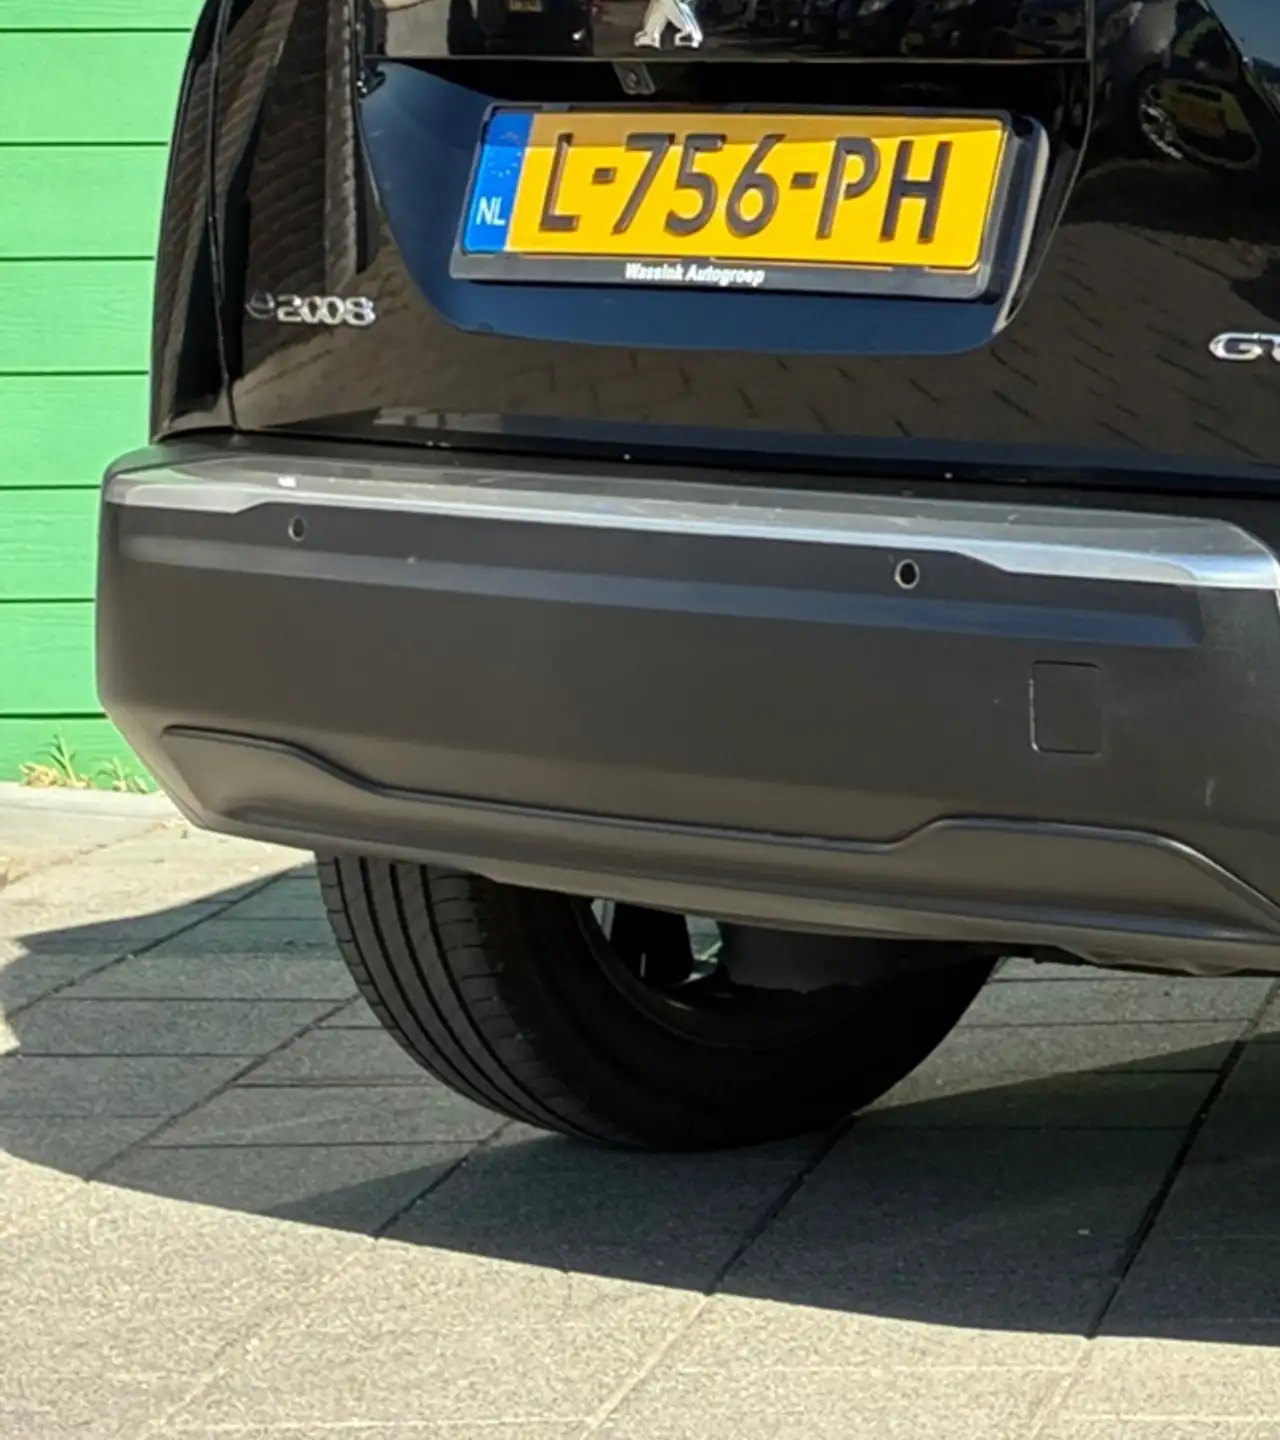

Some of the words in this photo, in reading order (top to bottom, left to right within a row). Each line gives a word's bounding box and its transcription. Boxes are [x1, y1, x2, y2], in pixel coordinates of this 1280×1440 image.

[538, 132, 954, 245] L-756-PH
[476, 195, 506, 227] NL
[624, 261, 685, 281] Wassink
[685, 263, 766, 287] Autogroep
